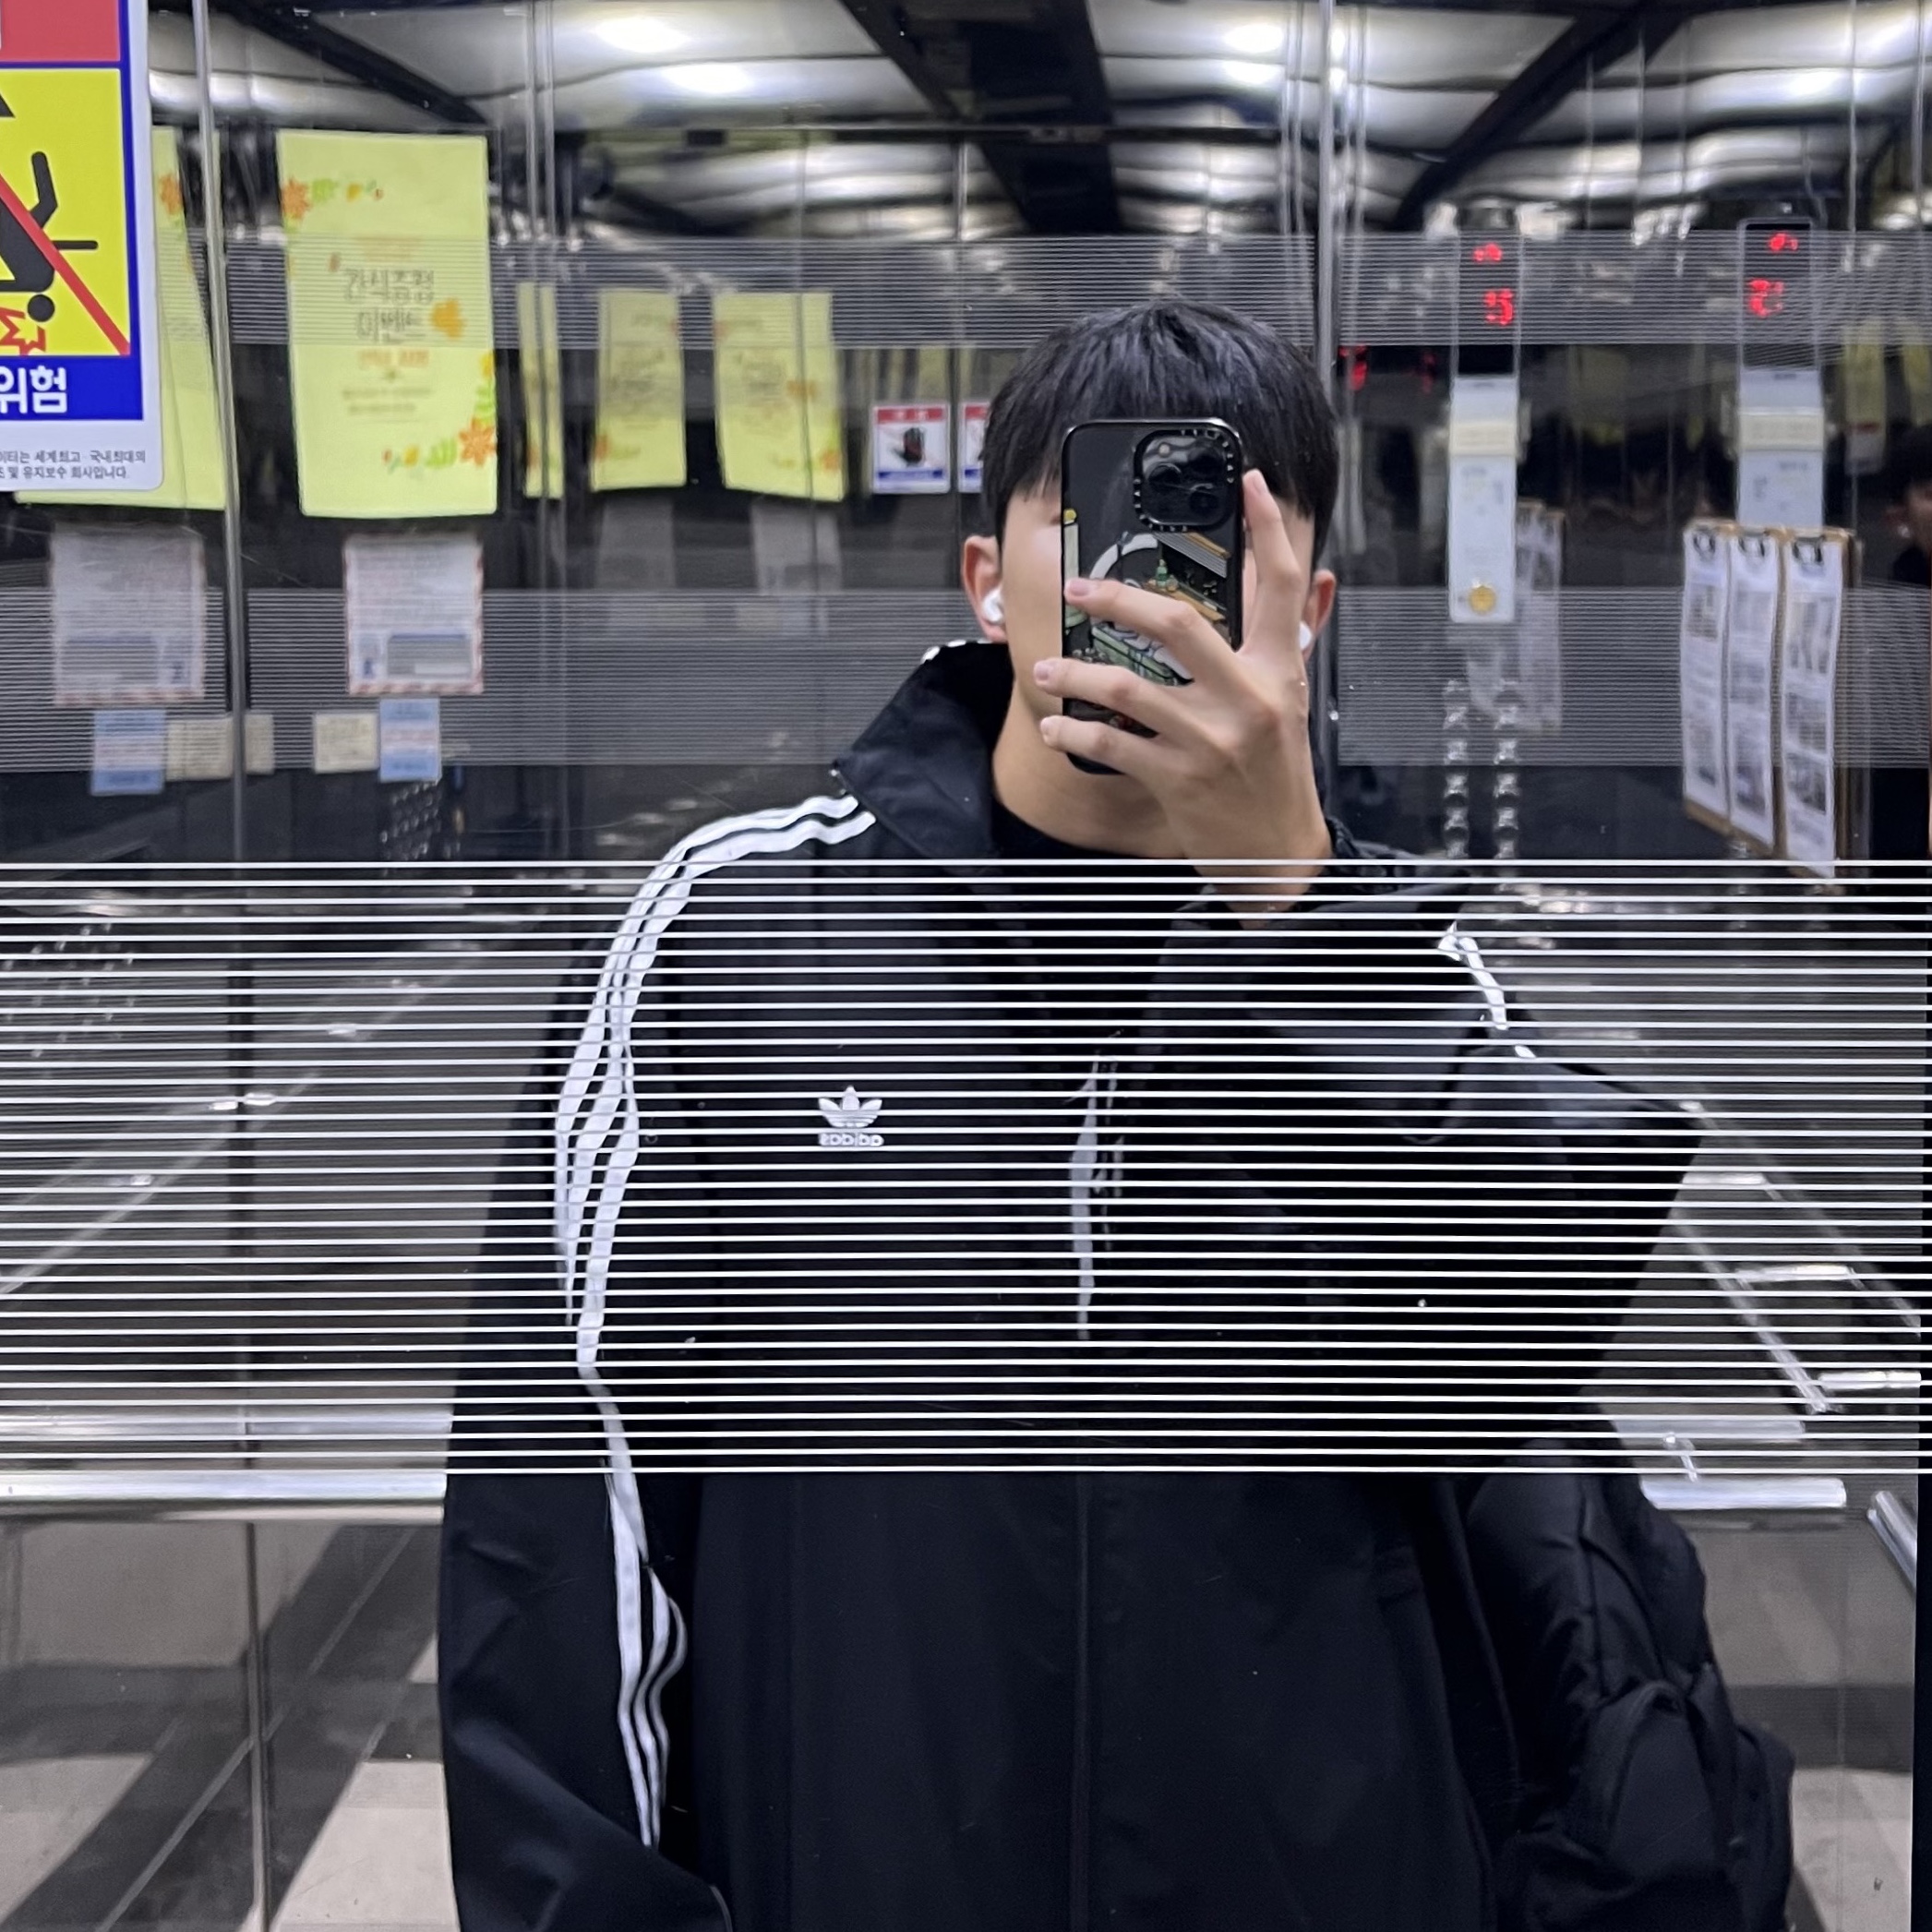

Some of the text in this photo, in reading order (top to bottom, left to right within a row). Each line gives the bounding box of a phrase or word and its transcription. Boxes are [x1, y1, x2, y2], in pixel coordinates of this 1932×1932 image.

[354, 307, 426, 344] 이벤트
[0, 365, 67, 414] 위험
[23, 466, 66, 479] 유지보수
